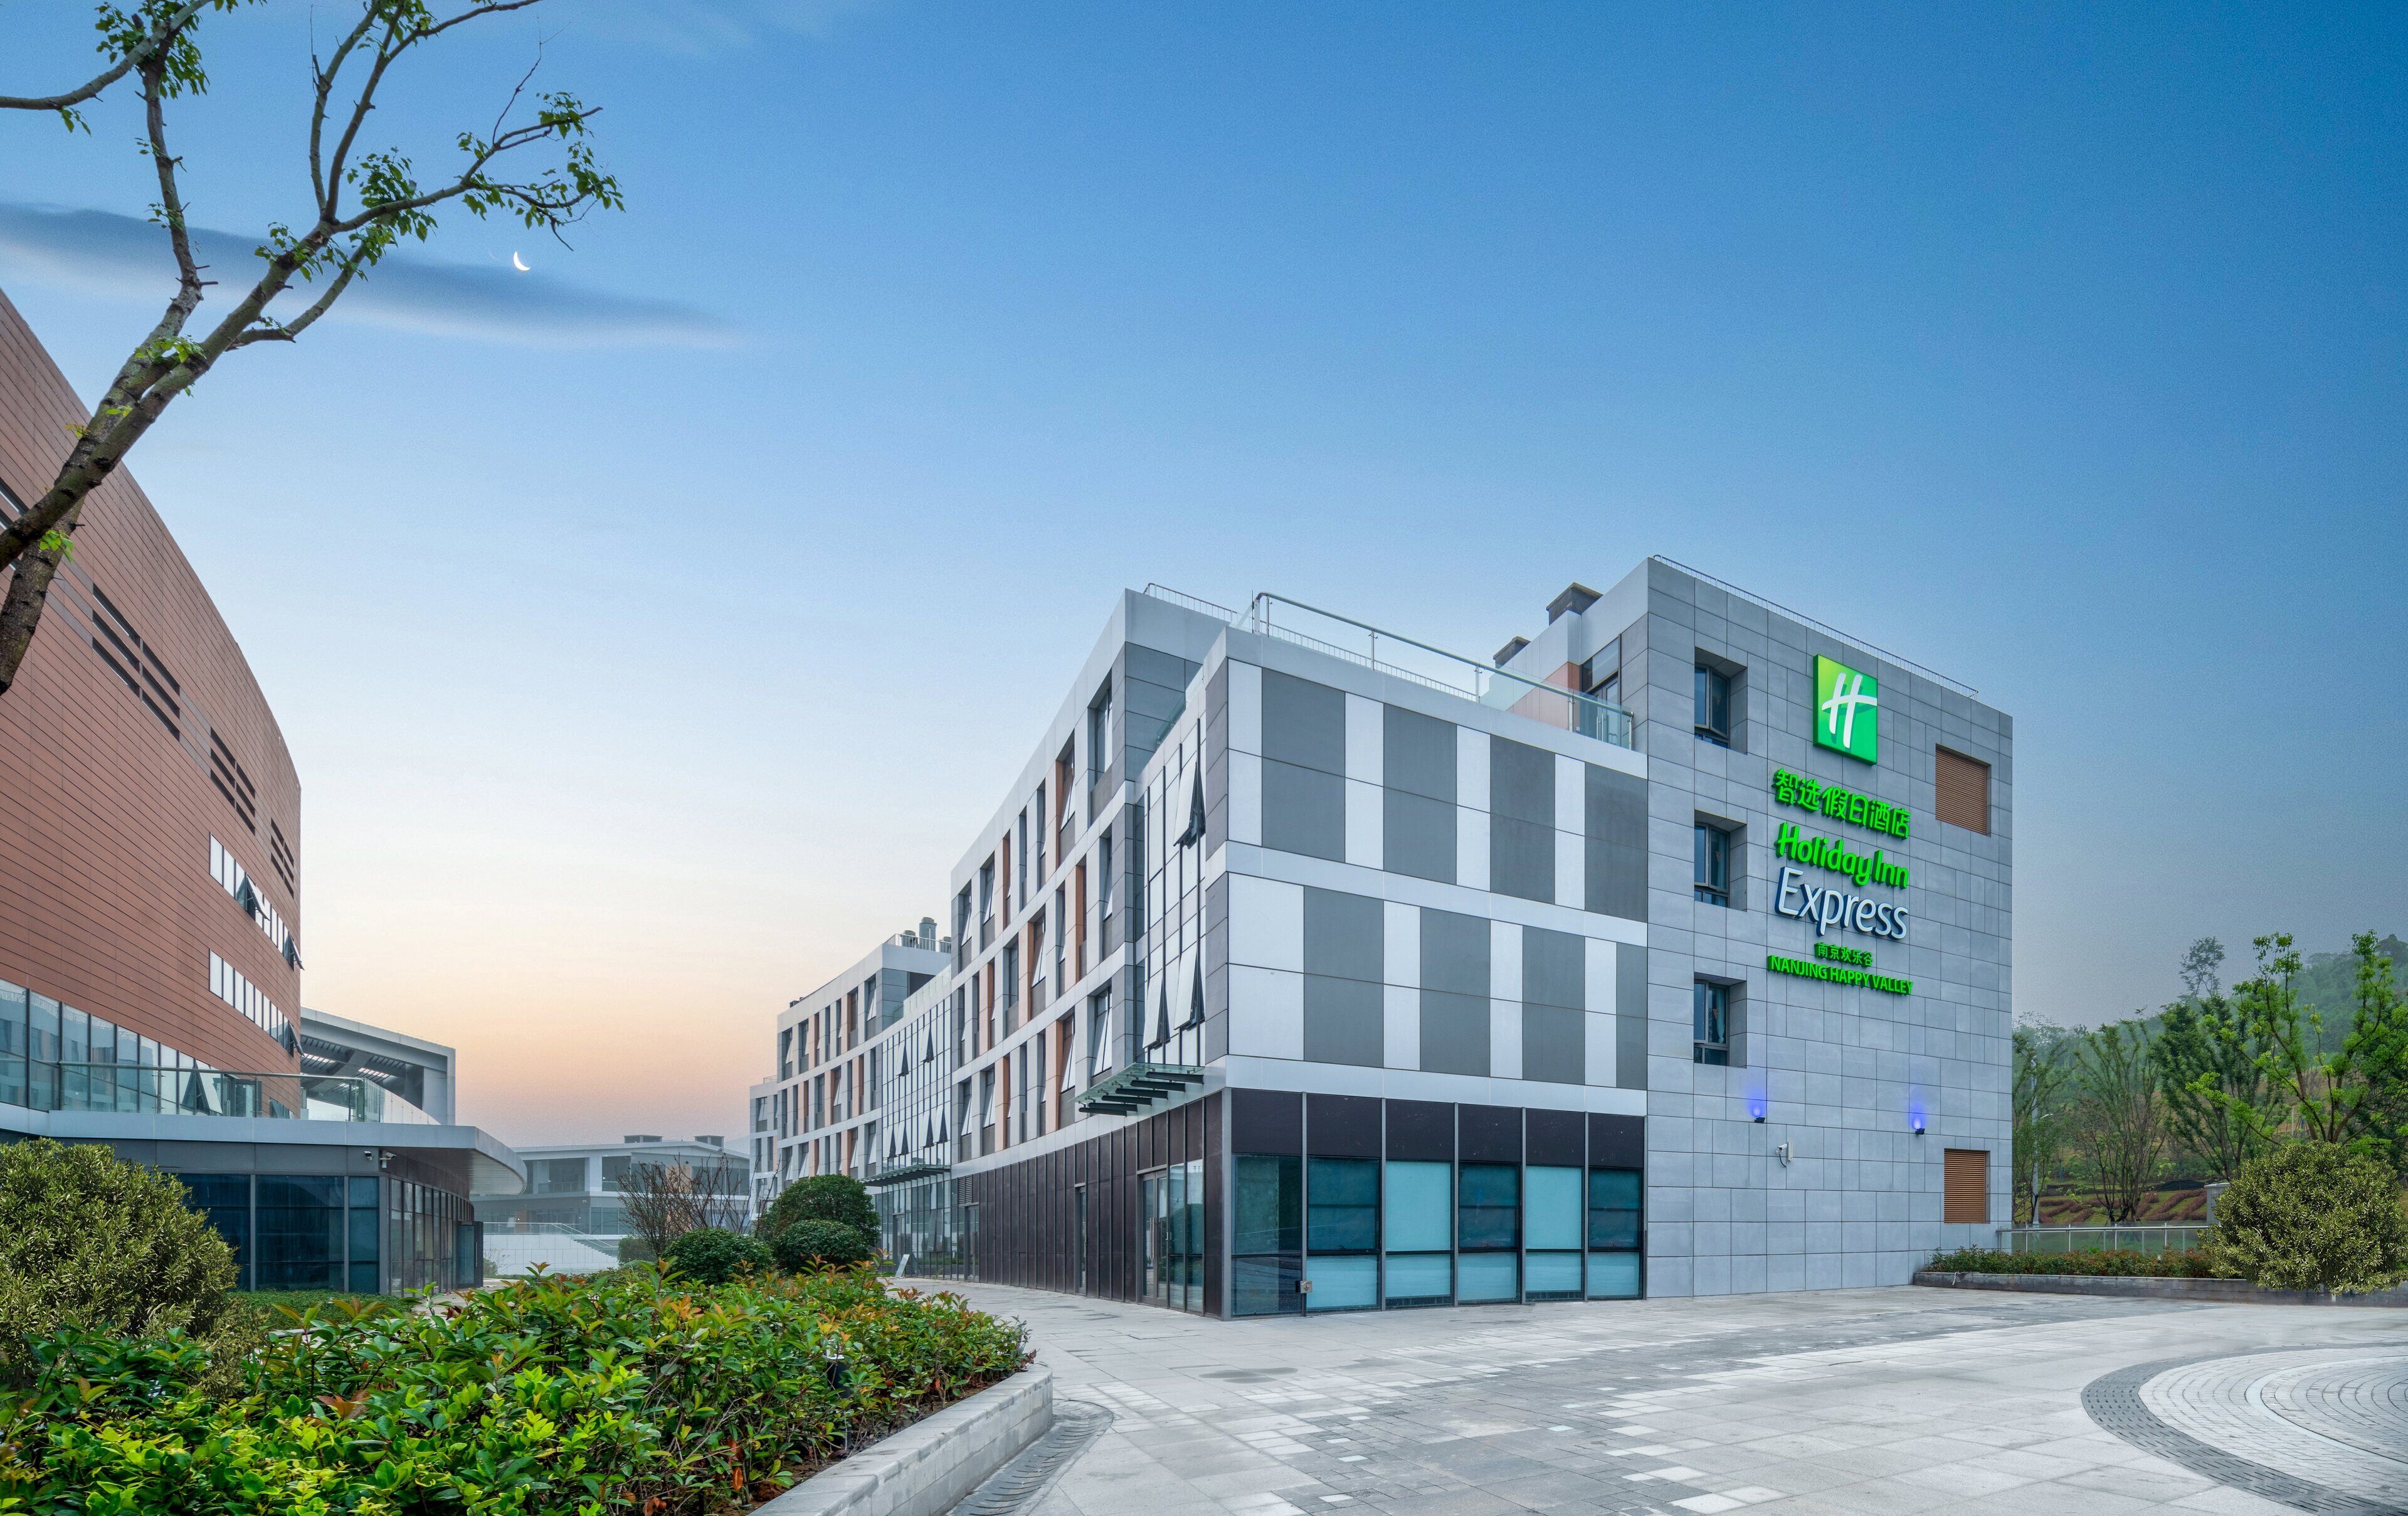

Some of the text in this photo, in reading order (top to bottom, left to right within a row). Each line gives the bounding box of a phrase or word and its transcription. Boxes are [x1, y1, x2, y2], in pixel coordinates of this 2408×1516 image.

[1773, 768, 1911, 839] 智选假日酒店
[1775, 822, 1909, 889] Holiday Inn
[1776, 866, 1908, 939] Express
[1769, 955, 1913, 994] NANJING HAPPY VALLEY
[1815, 942, 1873, 967] 南京欢乐谷
